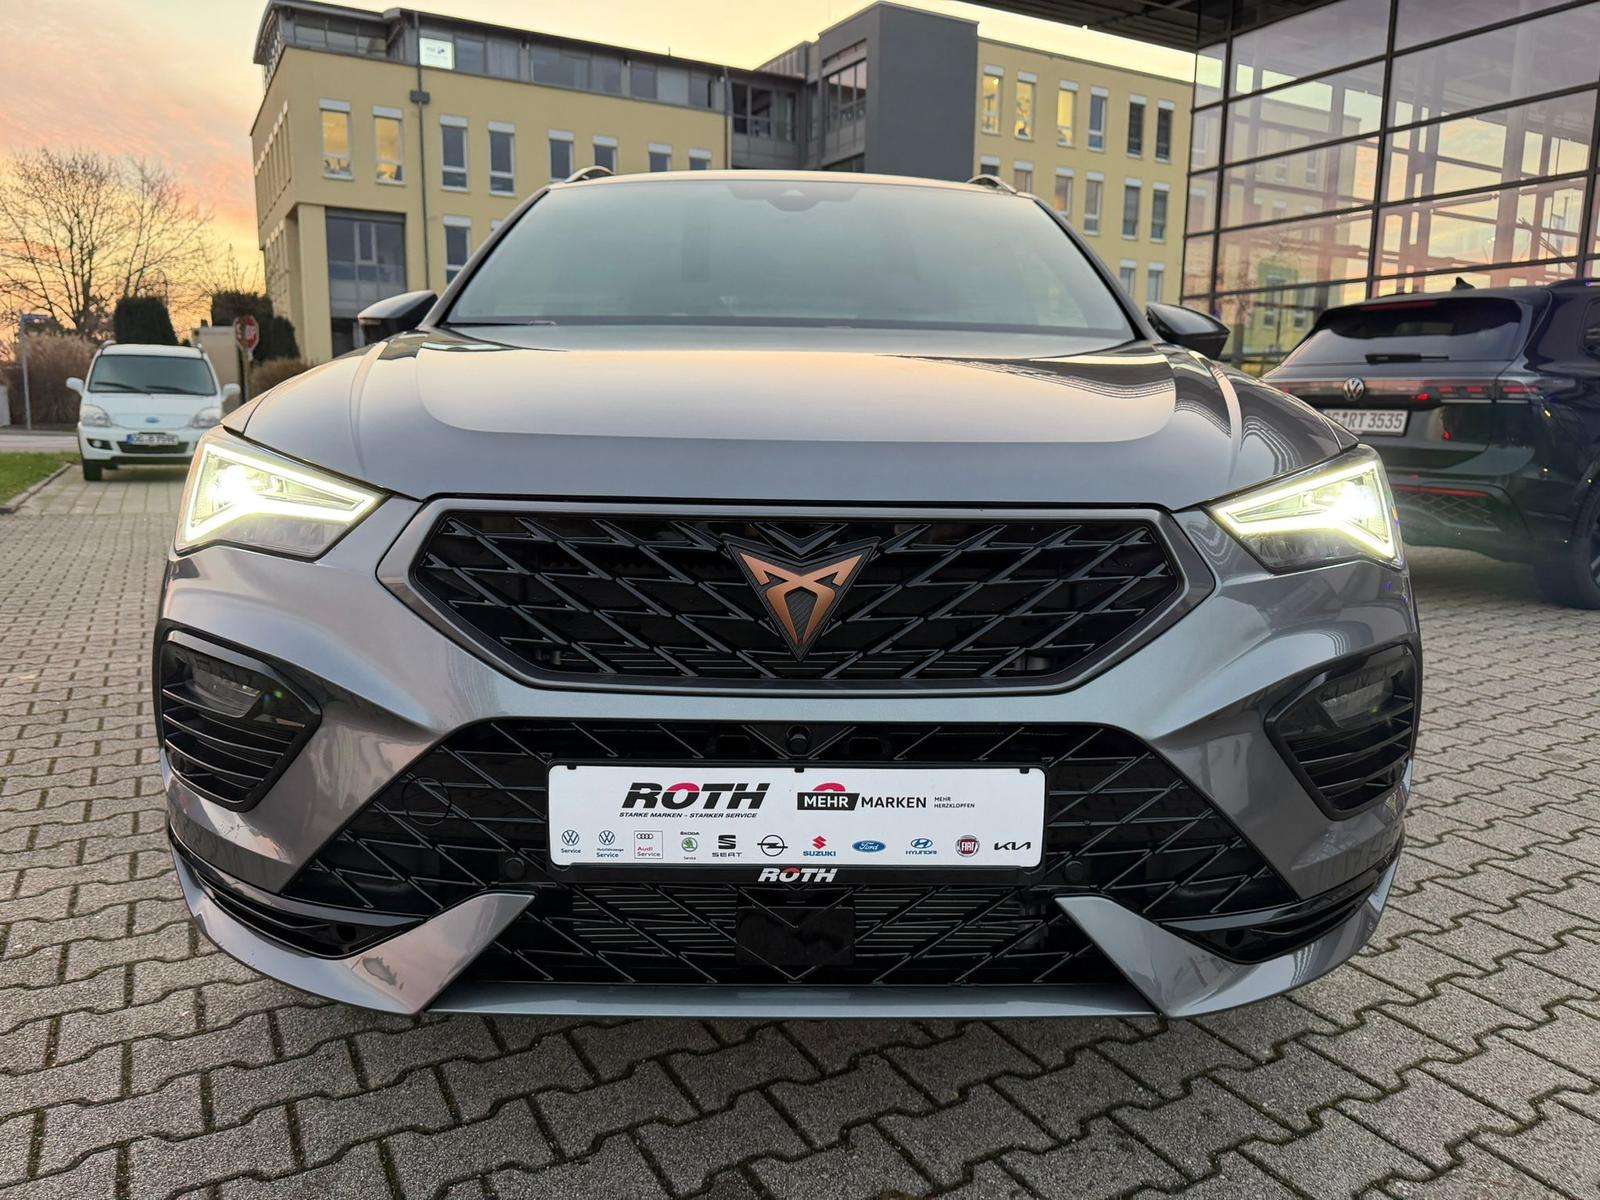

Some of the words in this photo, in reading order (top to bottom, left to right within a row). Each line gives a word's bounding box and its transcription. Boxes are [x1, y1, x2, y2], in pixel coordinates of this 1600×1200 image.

[1368, 412, 1405, 429] 3535
[621, 782, 771, 810] ROTH
[803, 795, 849, 808] MEHR
[861, 797, 927, 808] MARKEN
[858, 842, 879, 850] Ford
[961, 841, 975, 852] FIAT
[757, 866, 839, 883] ROTH
